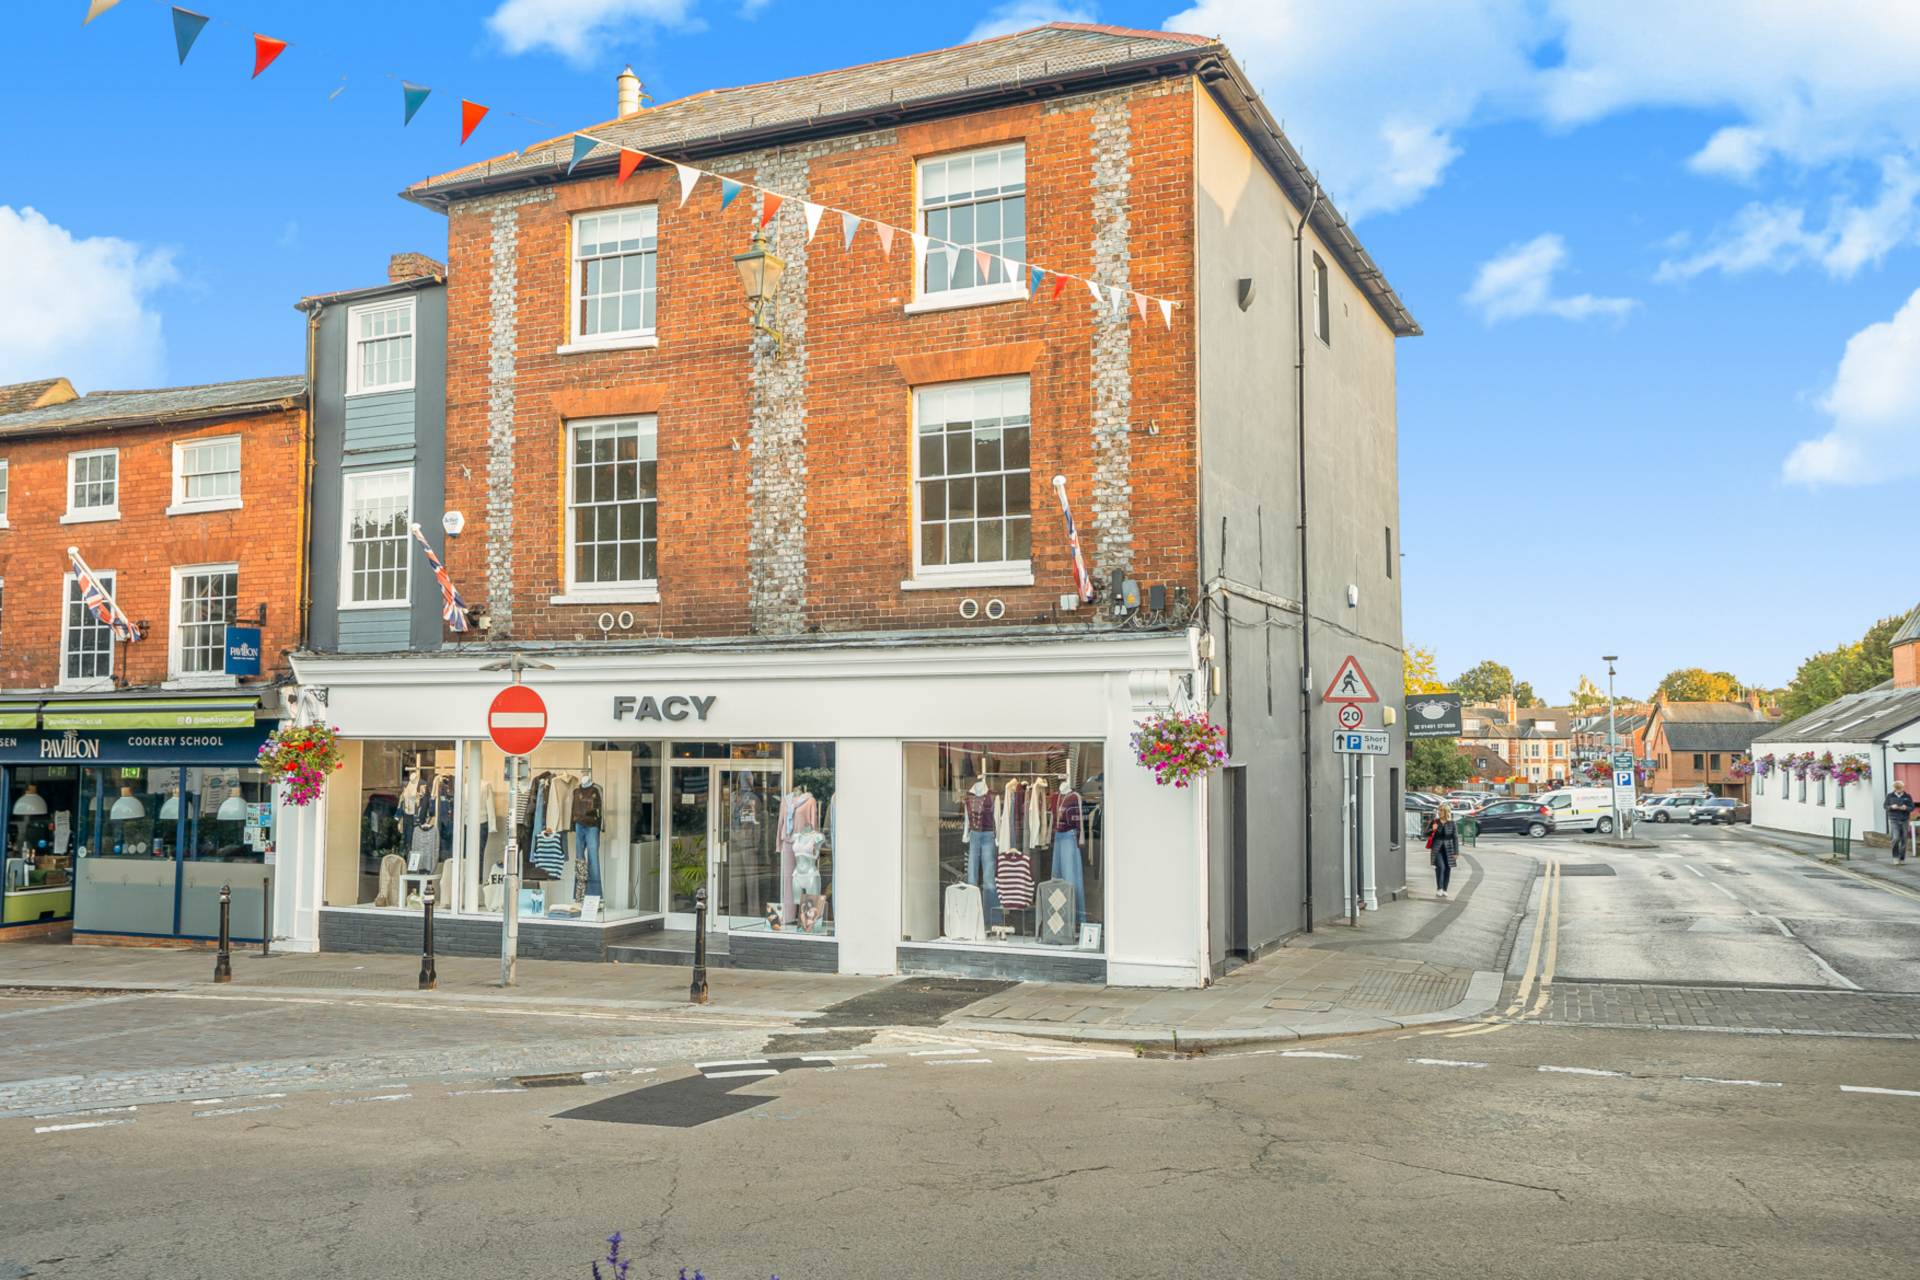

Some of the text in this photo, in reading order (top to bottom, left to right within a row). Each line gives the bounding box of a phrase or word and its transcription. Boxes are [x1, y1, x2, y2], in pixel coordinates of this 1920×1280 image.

[230, 645, 258, 657] PAVILION
[613, 695, 717, 721] FACY
[1343, 711, 1360, 721] 20
[128, 736, 224, 746] COOKERY SCHOOL
[1350, 737, 1360, 749] P
[1364, 735, 1387, 743] Short
[41, 734, 99, 758] PAVILION
[1367, 743, 1384, 751] stay
[1619, 773, 1629, 786] P
